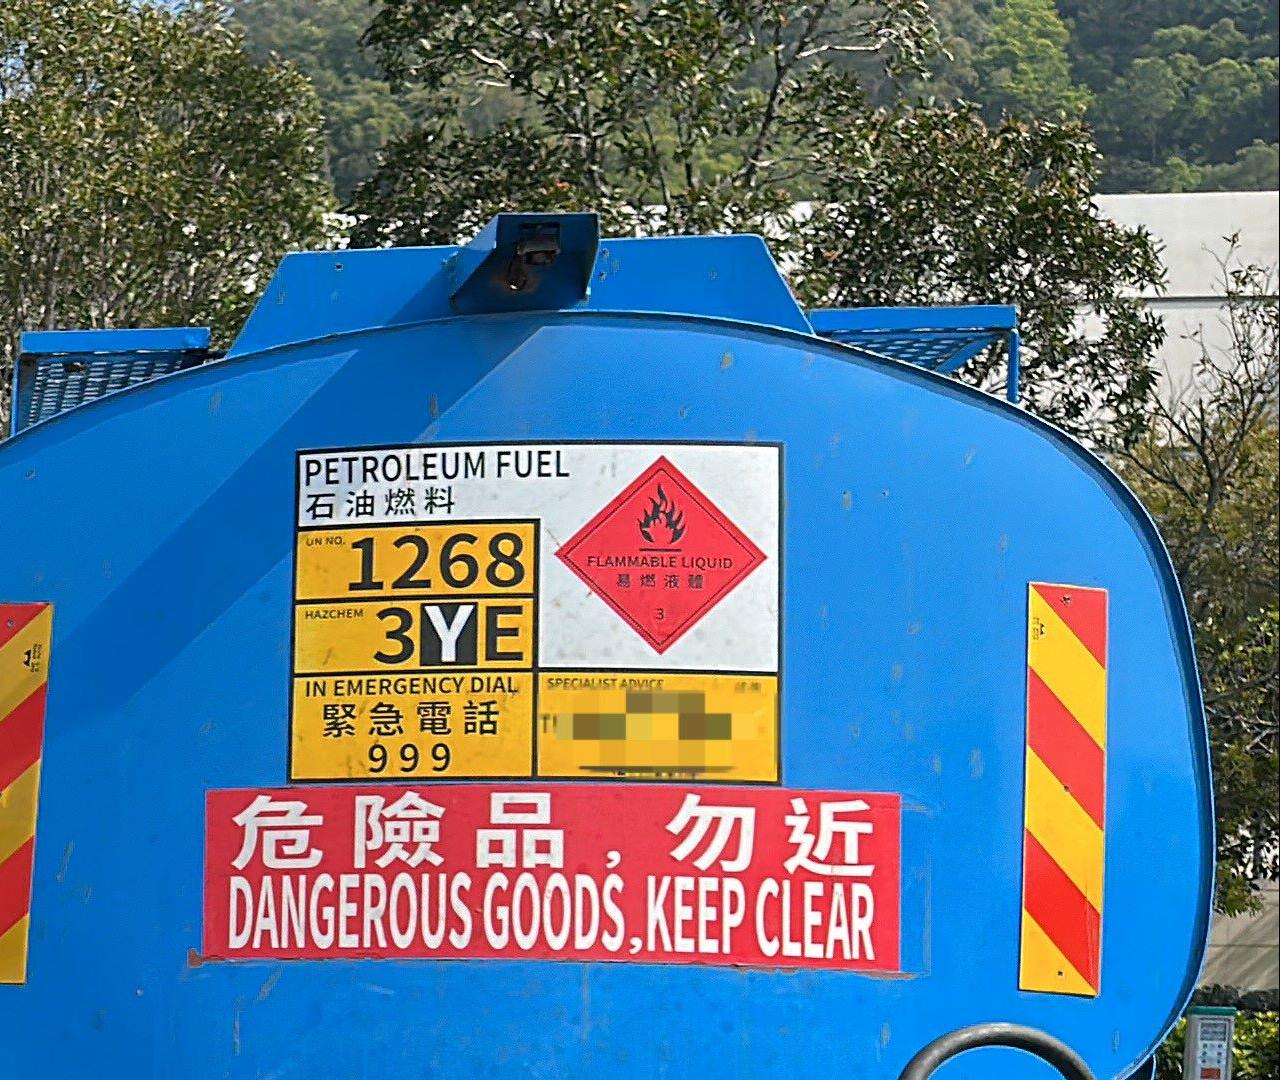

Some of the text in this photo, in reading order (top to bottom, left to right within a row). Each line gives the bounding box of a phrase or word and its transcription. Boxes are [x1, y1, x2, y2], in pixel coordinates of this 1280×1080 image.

[304, 450, 570, 486] PETROLEUM FUEL
[305, 486, 455, 519] 石油燃料
[305, 536, 346, 546] UN NO.
[348, 533, 526, 592] 1268
[587, 556, 733, 570] FLAMMABLE LIQUID
[305, 609, 364, 619] HAZCHEM
[655, 608, 665, 620] 3
[373, 605, 524, 665] 3YE
[305, 676, 518, 696] IN EMERGENCY DIAL
[547, 678, 664, 690] SPECIALIST ADVICE
[322, 700, 500, 738] 緊急電話
[368, 743, 451, 774] 999
[228, 872, 472, 950] DANGEROUS
[646, 875, 748, 955] KEEP
[755, 877, 875, 961] CLEAR
